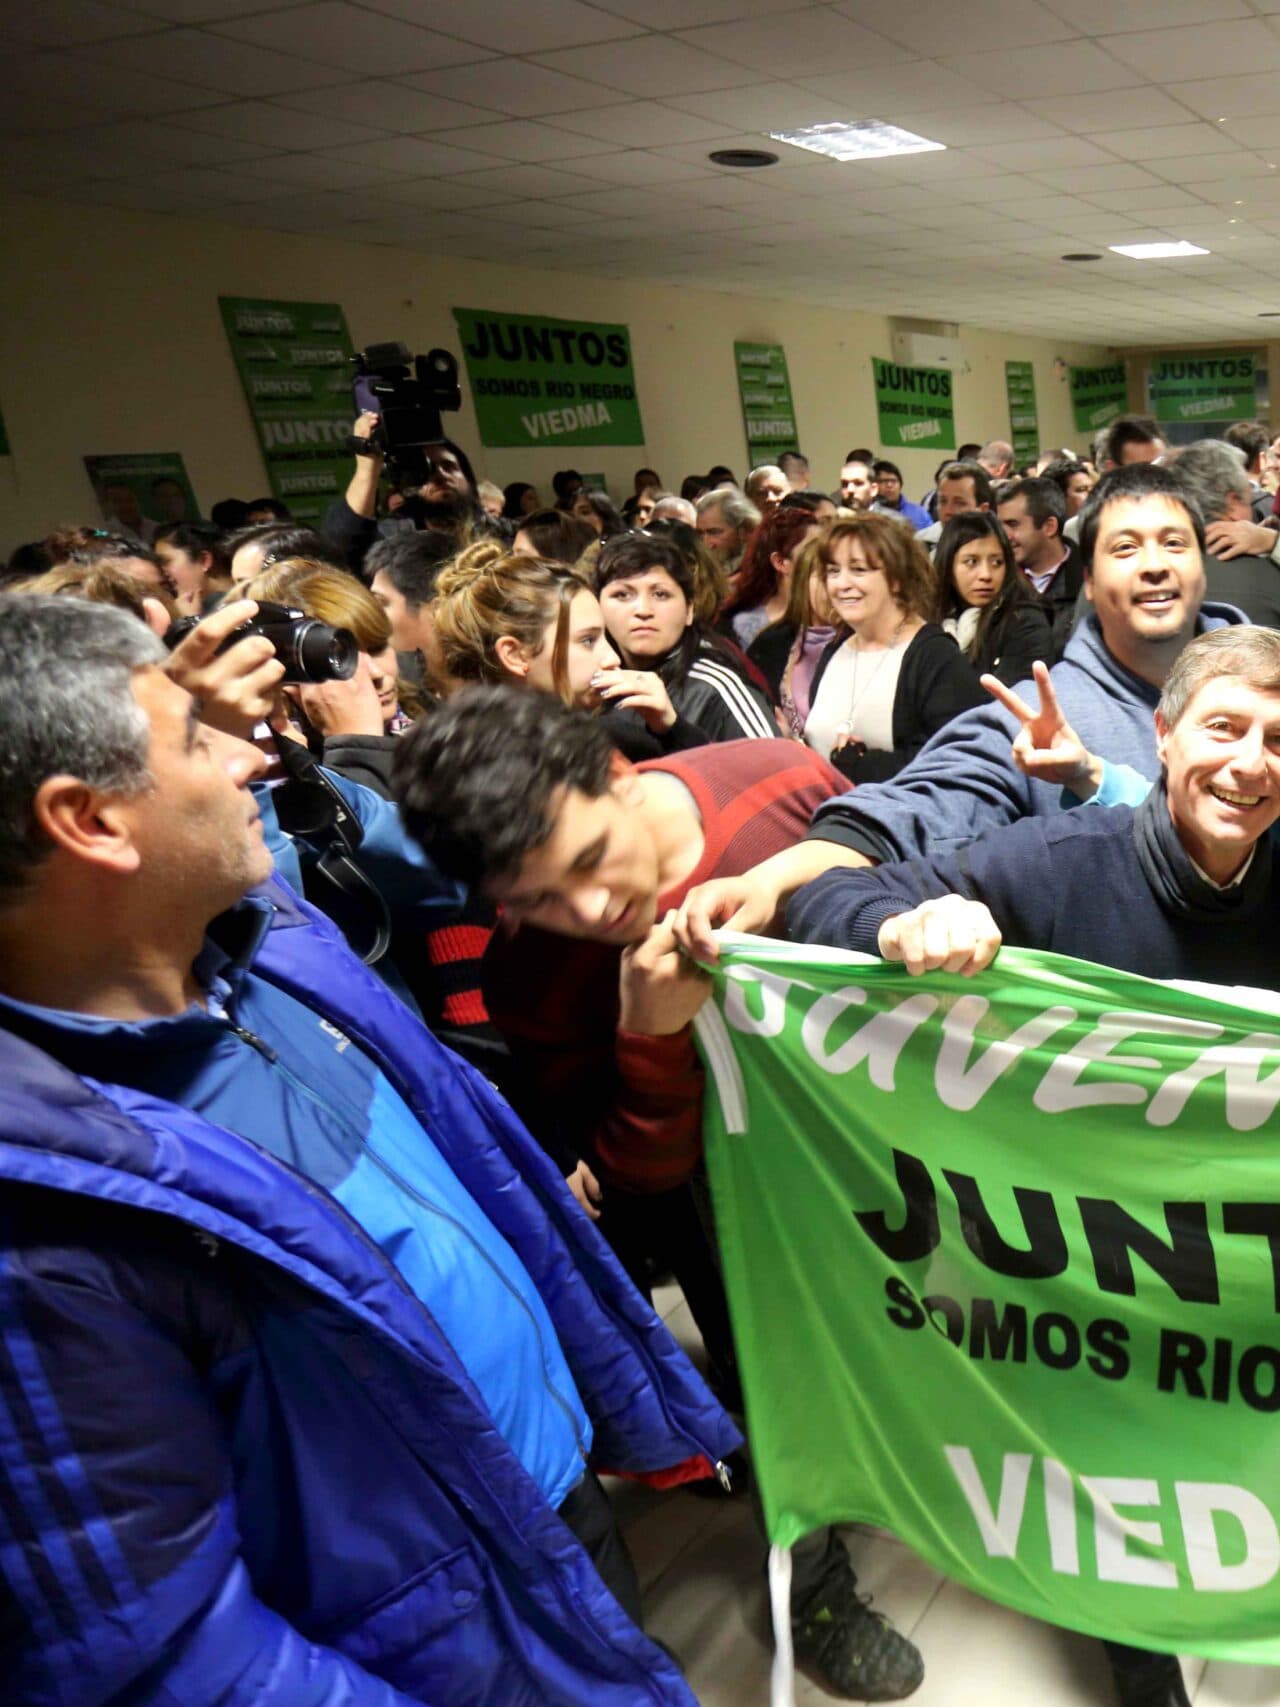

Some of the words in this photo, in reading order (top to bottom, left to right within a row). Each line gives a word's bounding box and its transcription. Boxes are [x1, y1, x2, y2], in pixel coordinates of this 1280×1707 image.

[467, 322, 628, 369] JUNTOS
[877, 363, 951, 398] JUNTOS
[1156, 358, 1253, 381] JUNTOS
[476, 378, 541, 398] SOMOS
[546, 381, 575, 398] RIO
[581, 382, 635, 401] NEGRO
[262, 420, 356, 448] JUNTO
[520, 401, 613, 439] VIEDMA
[885, 1275, 1131, 1381] SOMOS
